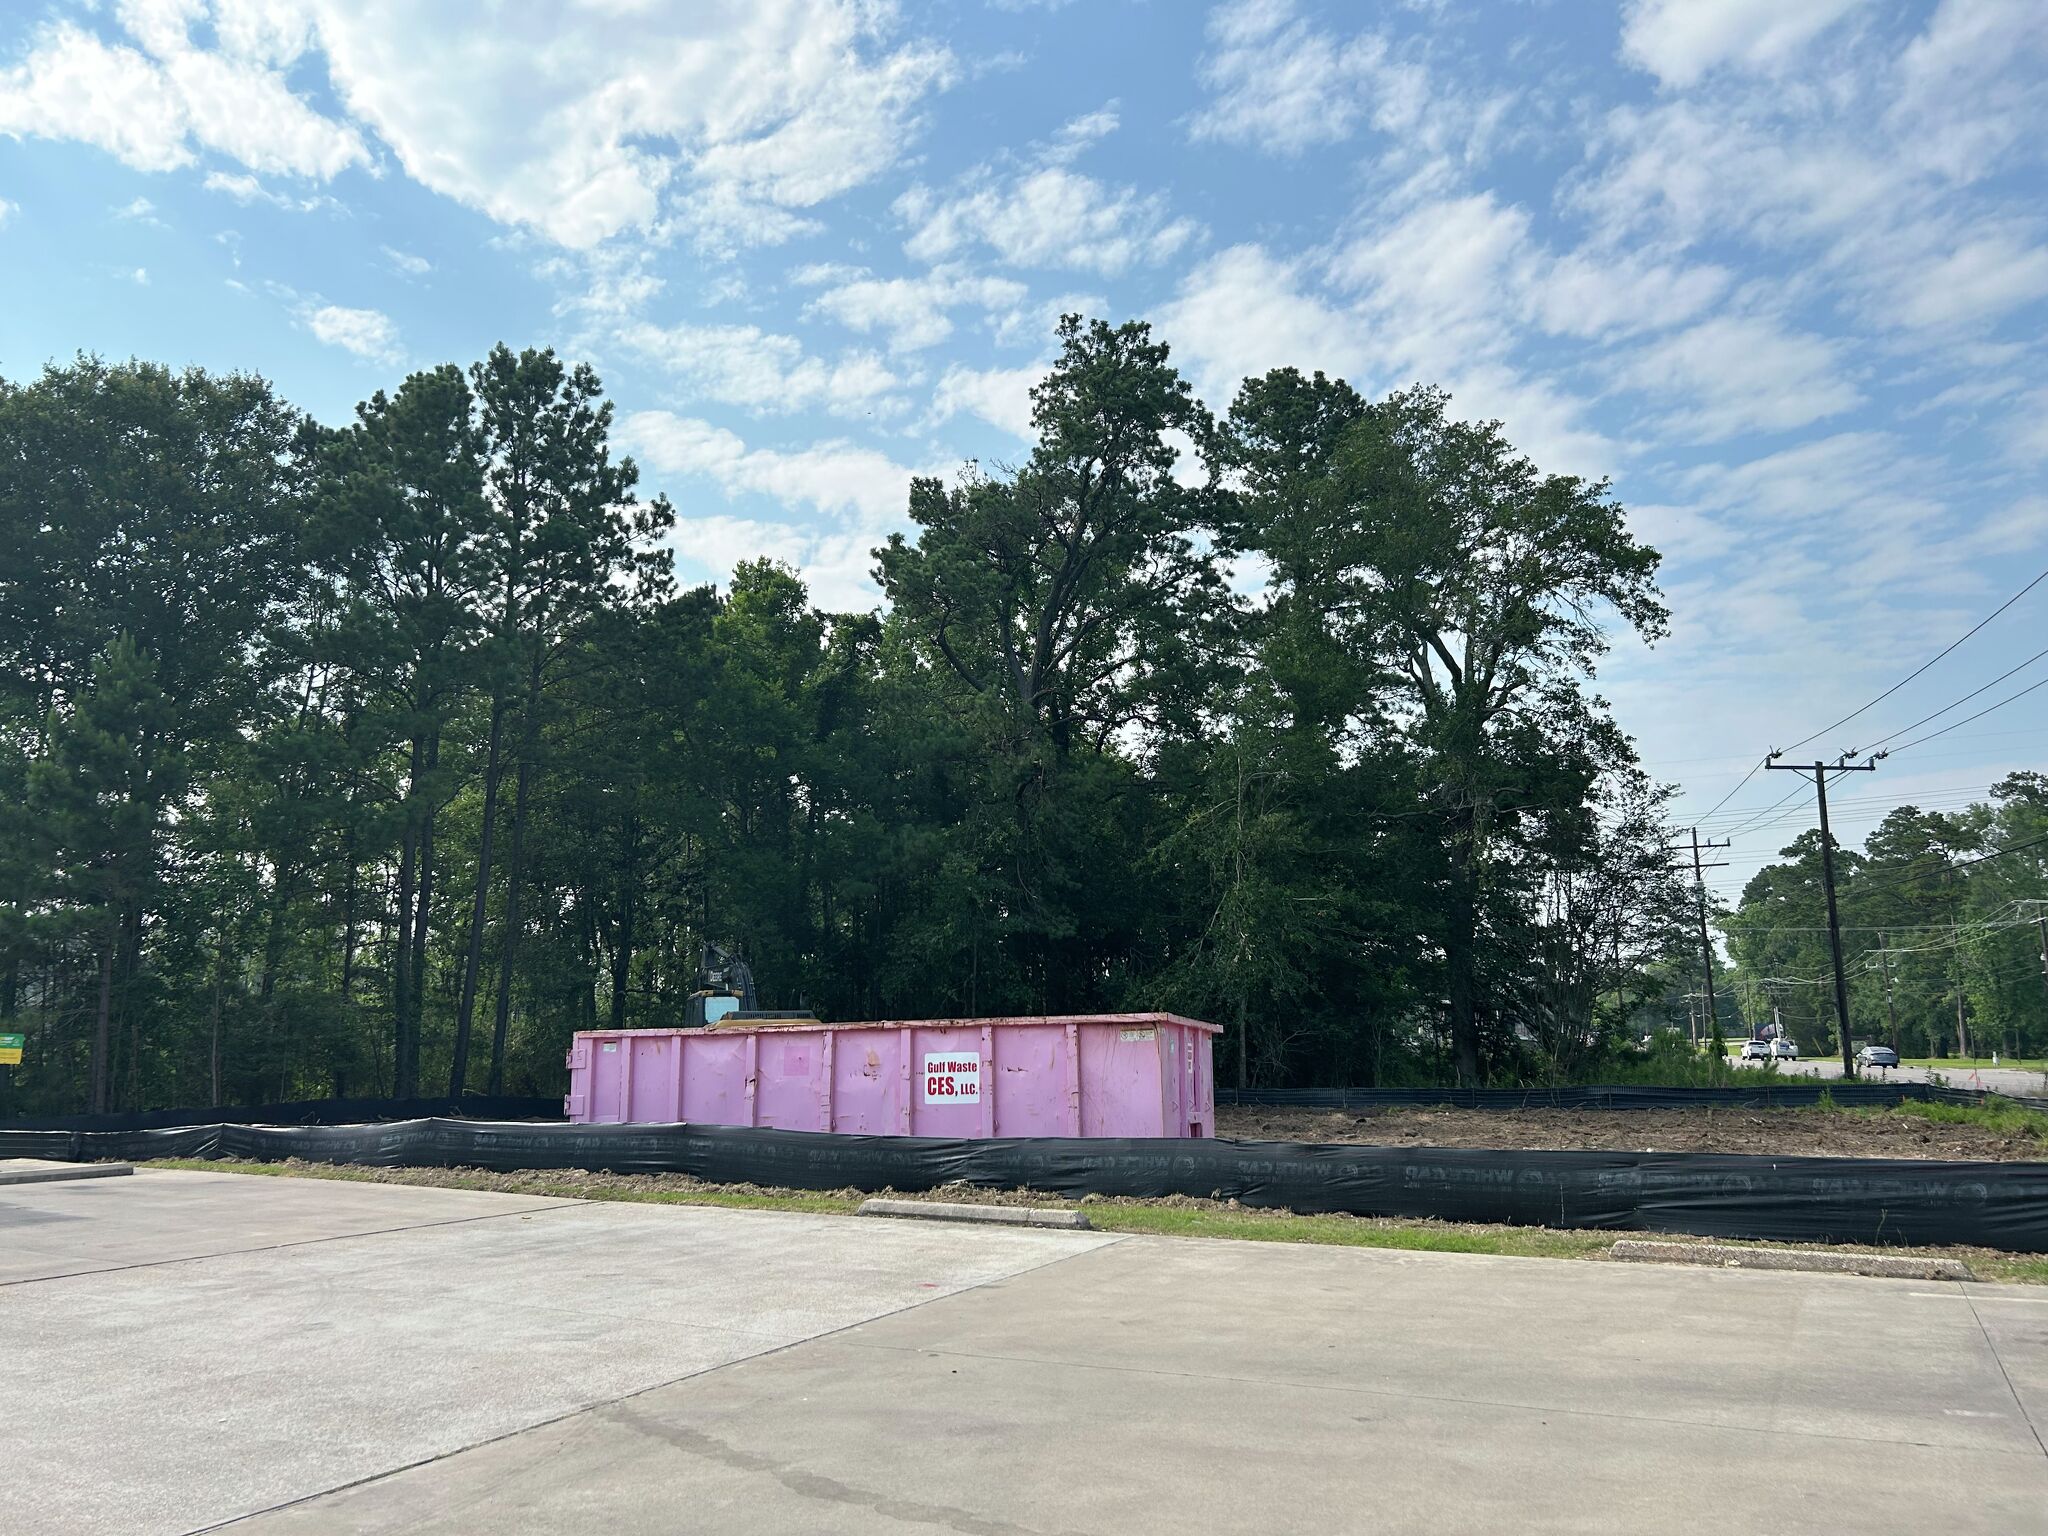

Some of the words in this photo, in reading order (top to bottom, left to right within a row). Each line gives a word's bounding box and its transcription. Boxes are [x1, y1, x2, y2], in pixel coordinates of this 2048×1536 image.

[928, 1061, 945, 1073] Gulf
[947, 1061, 977, 1072] Waste
[927, 1076, 958, 1096] CES,
[960, 1083, 978, 1095] LLC.
